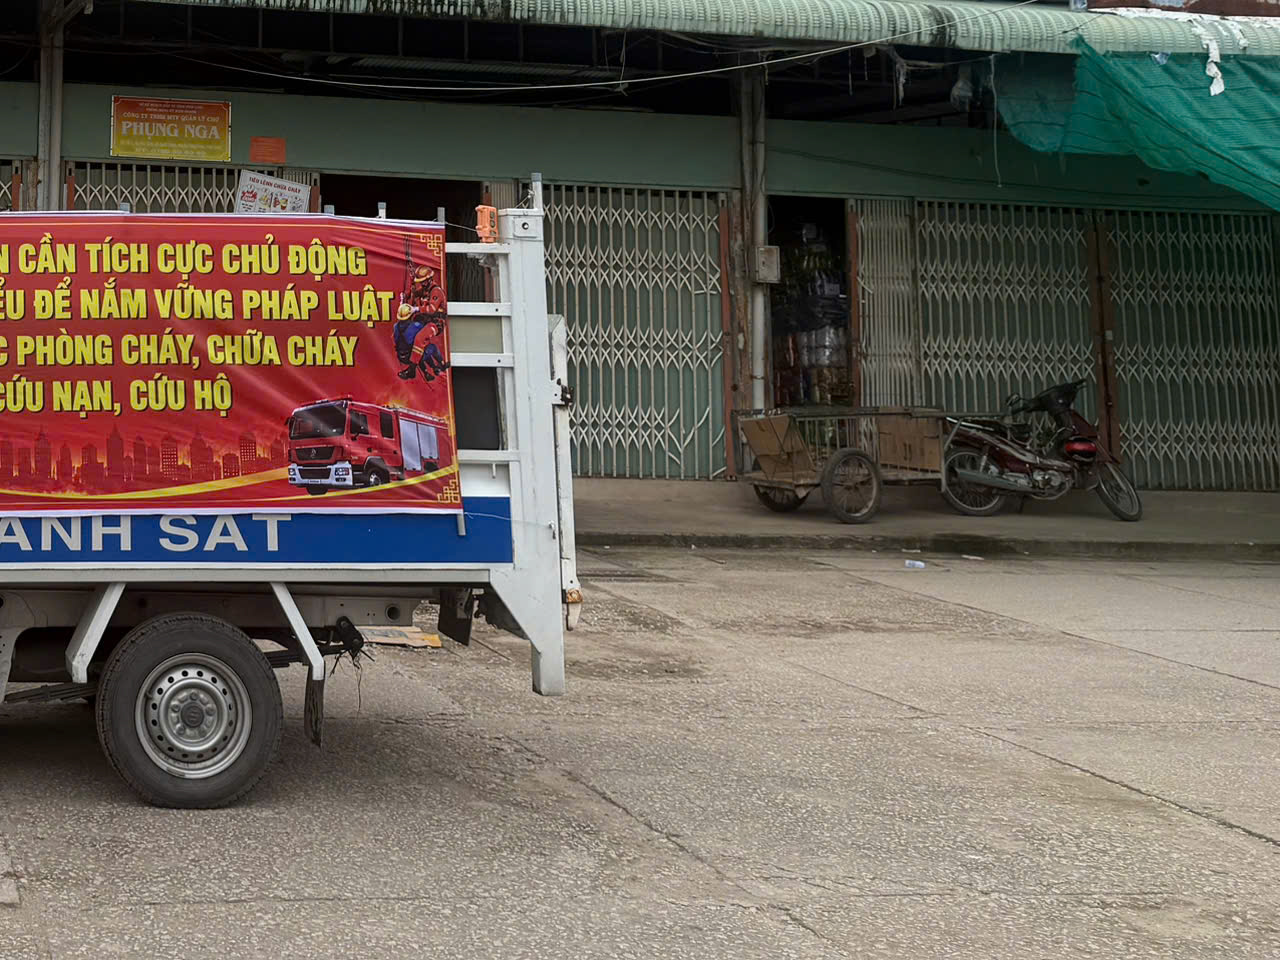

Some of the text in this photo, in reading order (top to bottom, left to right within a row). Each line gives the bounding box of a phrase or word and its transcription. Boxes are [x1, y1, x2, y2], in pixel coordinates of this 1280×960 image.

[121, 121, 221, 140] PHỤNG NGA
[19, 233, 76, 273] CẦN
[85, 236, 149, 273] TÍCH
[157, 240, 214, 280] CỰC
[222, 234, 279, 274] CHỦ
[288, 238, 367, 281] ĐỘNG
[34, 276, 72, 320] ĐỂ
[80, 278, 148, 319] NẮM
[154, 282, 233, 319] VỮNG
[243, 283, 319, 320] PHÁP
[327, 284, 394, 327] LUẬT
[17, 328, 113, 366] PHÒNG
[121, 328, 200, 369] CHÁY,
[207, 329, 281, 366] CHỮA
[288, 330, 358, 366] CHÁY
[53, 380, 121, 417] NẠN,
[130, 373, 186, 411] CỨU
[194, 373, 232, 417] HỘ
